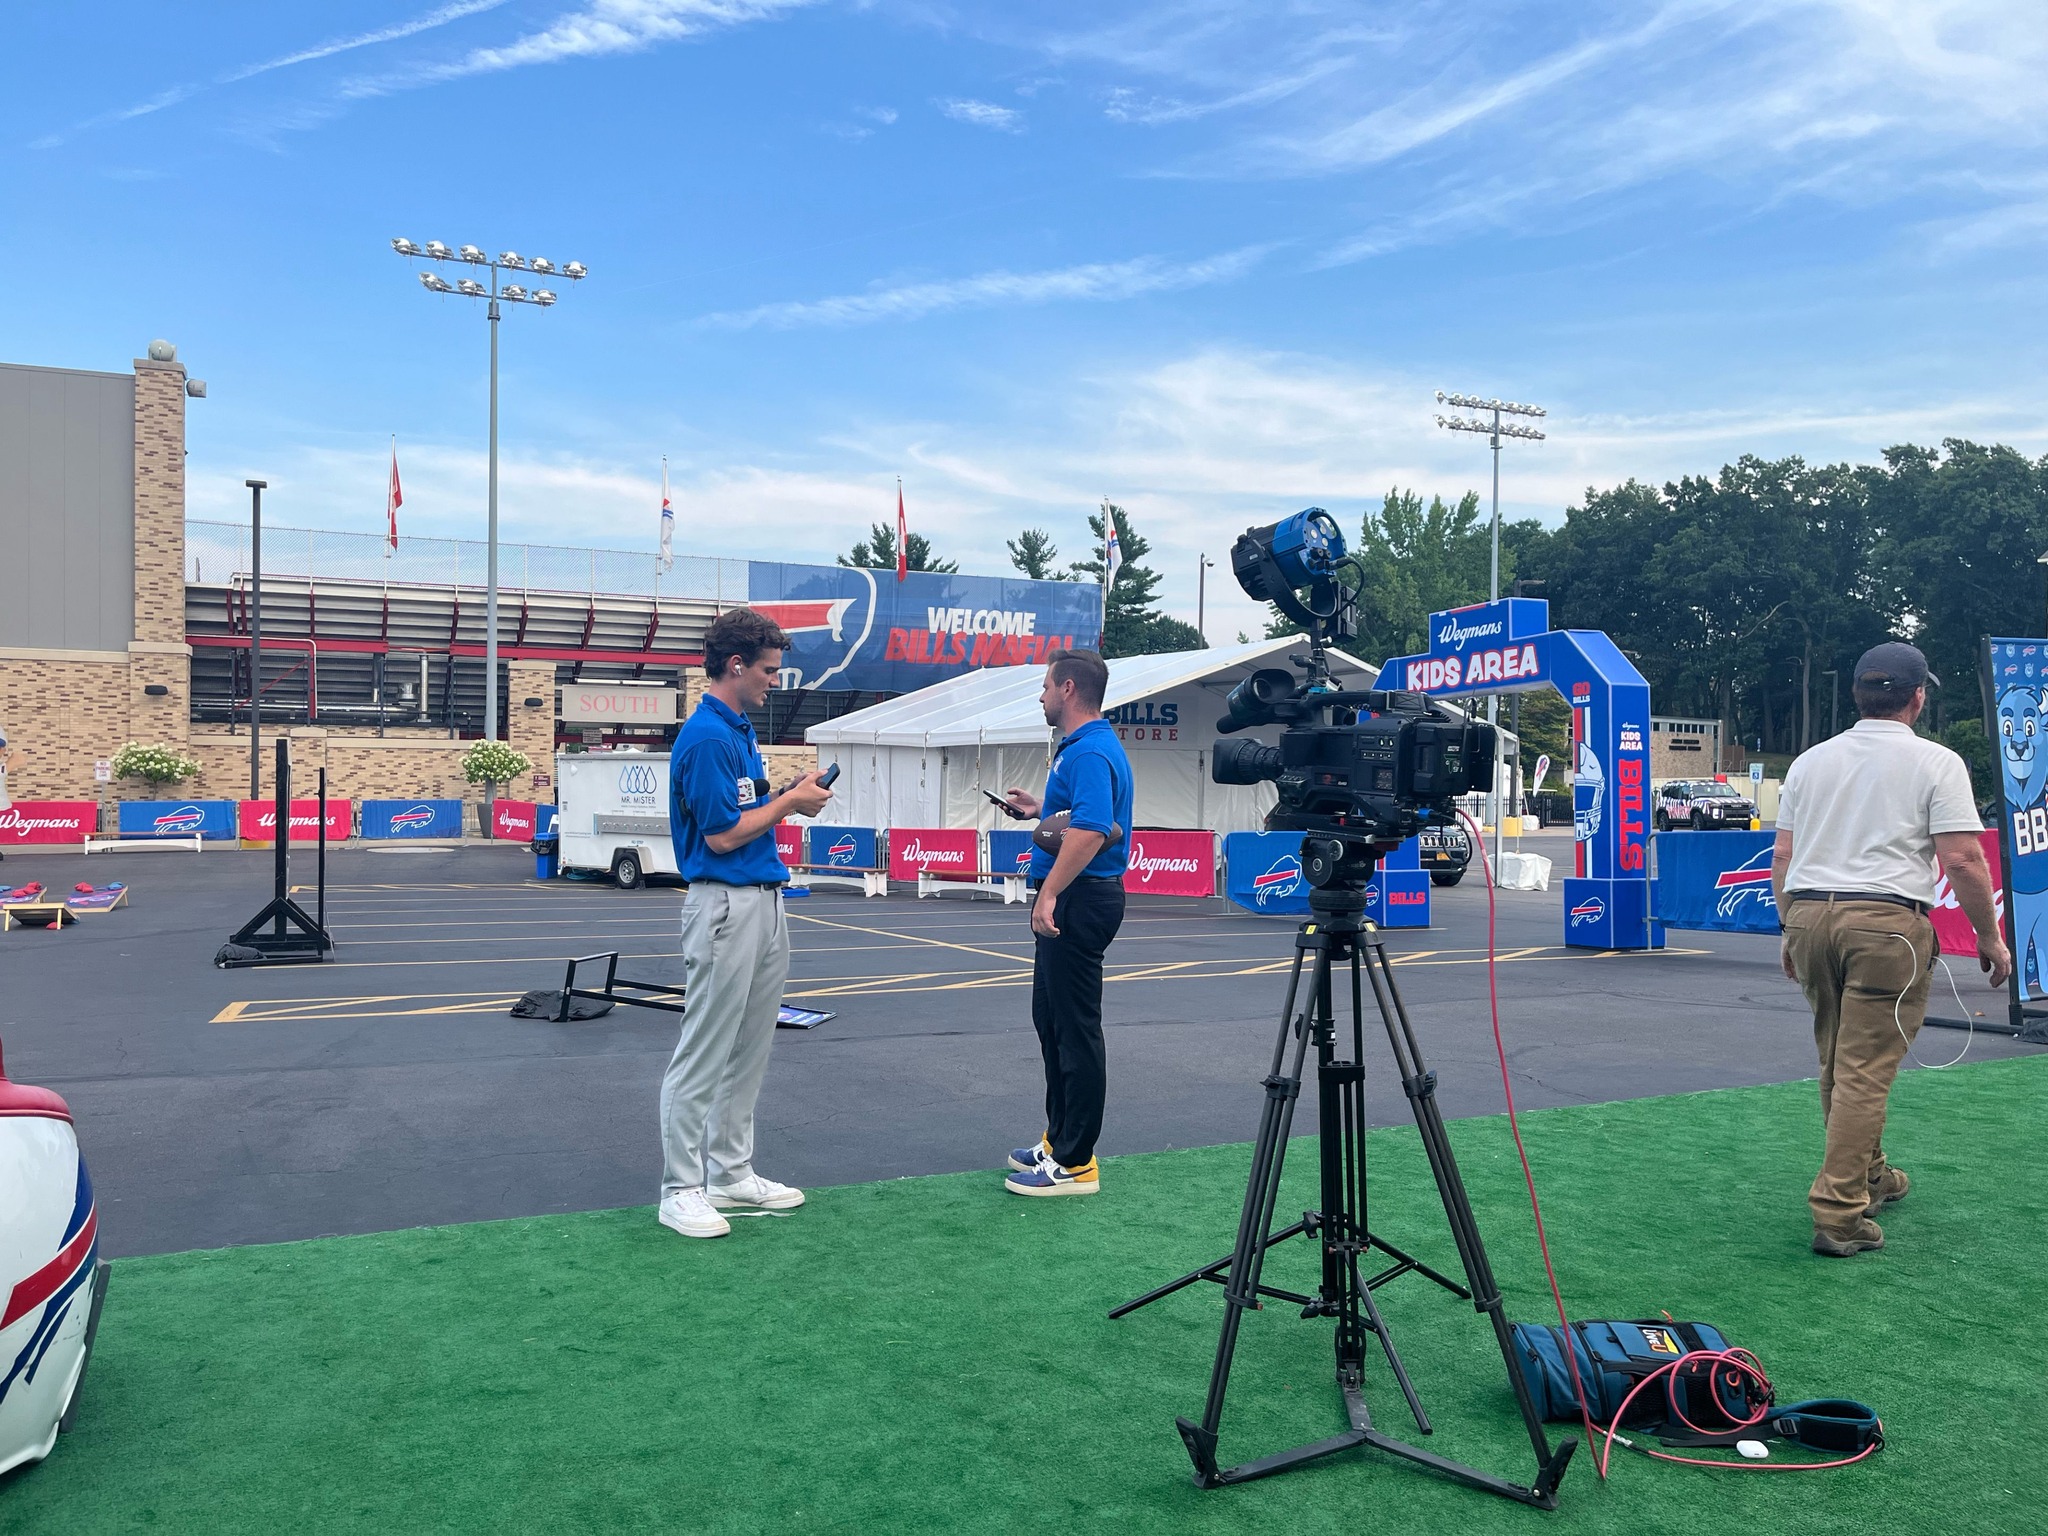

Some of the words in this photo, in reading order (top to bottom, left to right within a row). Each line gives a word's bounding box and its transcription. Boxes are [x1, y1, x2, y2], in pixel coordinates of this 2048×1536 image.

[927, 607, 1036, 637] WELCOME
[884, 627, 968, 665] BILLS
[1437, 617, 1502, 652] Wegmans
[1407, 656, 1462, 692] KIDS
[1464, 643, 1540, 685] AREA
[1572, 682, 1591, 696] GO
[580, 694, 658, 714] SOUTH
[1103, 702, 1178, 725] BILLS
[1118, 727, 1178, 741] TORE
[1619, 741, 1643, 751] AREA
[1620, 731, 1641, 741] KIDS
[633, 796, 656, 805] MISTER
[0, 809, 80, 837] Wegmans
[499, 808, 529, 832] Wegmans
[1618, 759, 1644, 871] BILLS
[901, 837, 964, 870] Wegmans
[1127, 842, 1199, 883] Wegmans
[1388, 892, 1426, 906] BILLS
